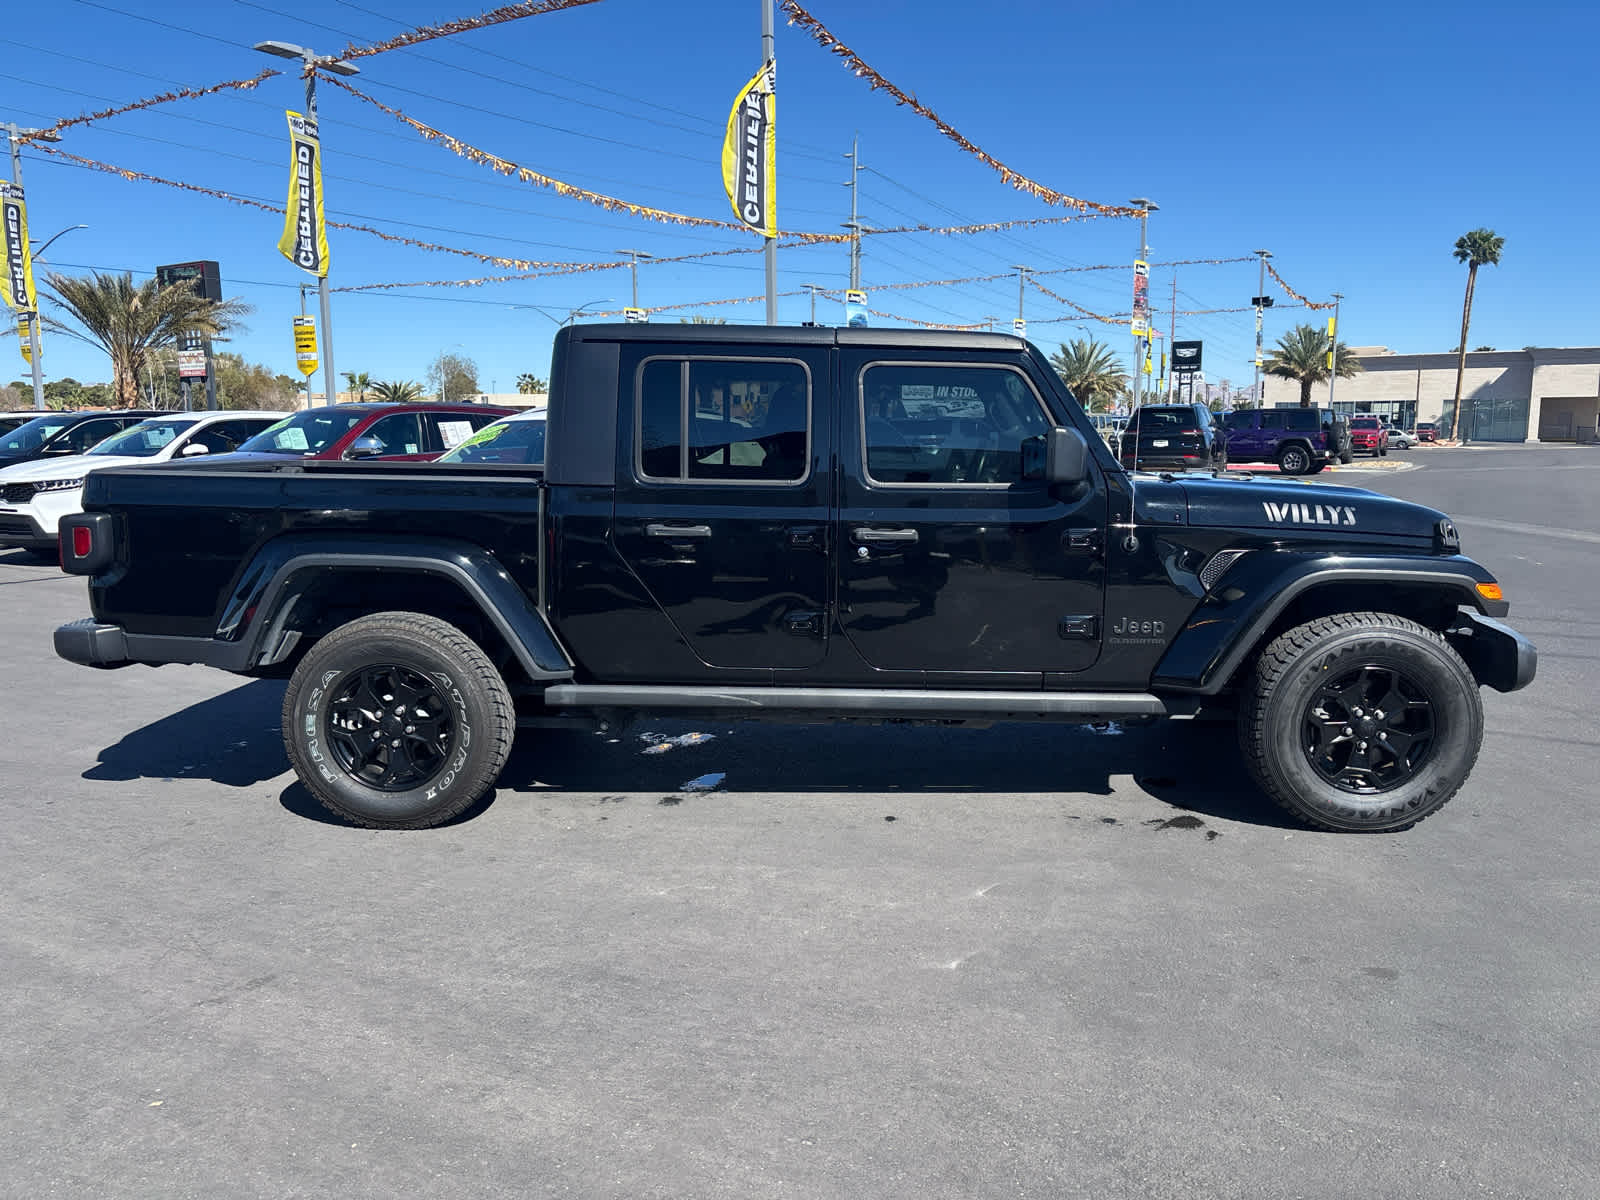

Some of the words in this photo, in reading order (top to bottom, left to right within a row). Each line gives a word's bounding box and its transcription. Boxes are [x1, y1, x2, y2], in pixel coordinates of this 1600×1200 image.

[936, 386, 949, 397] IN
[951, 386, 978, 398] STOC
[1262, 502, 1356, 525] WILLYS
[1113, 617, 1166, 636] Jeep
